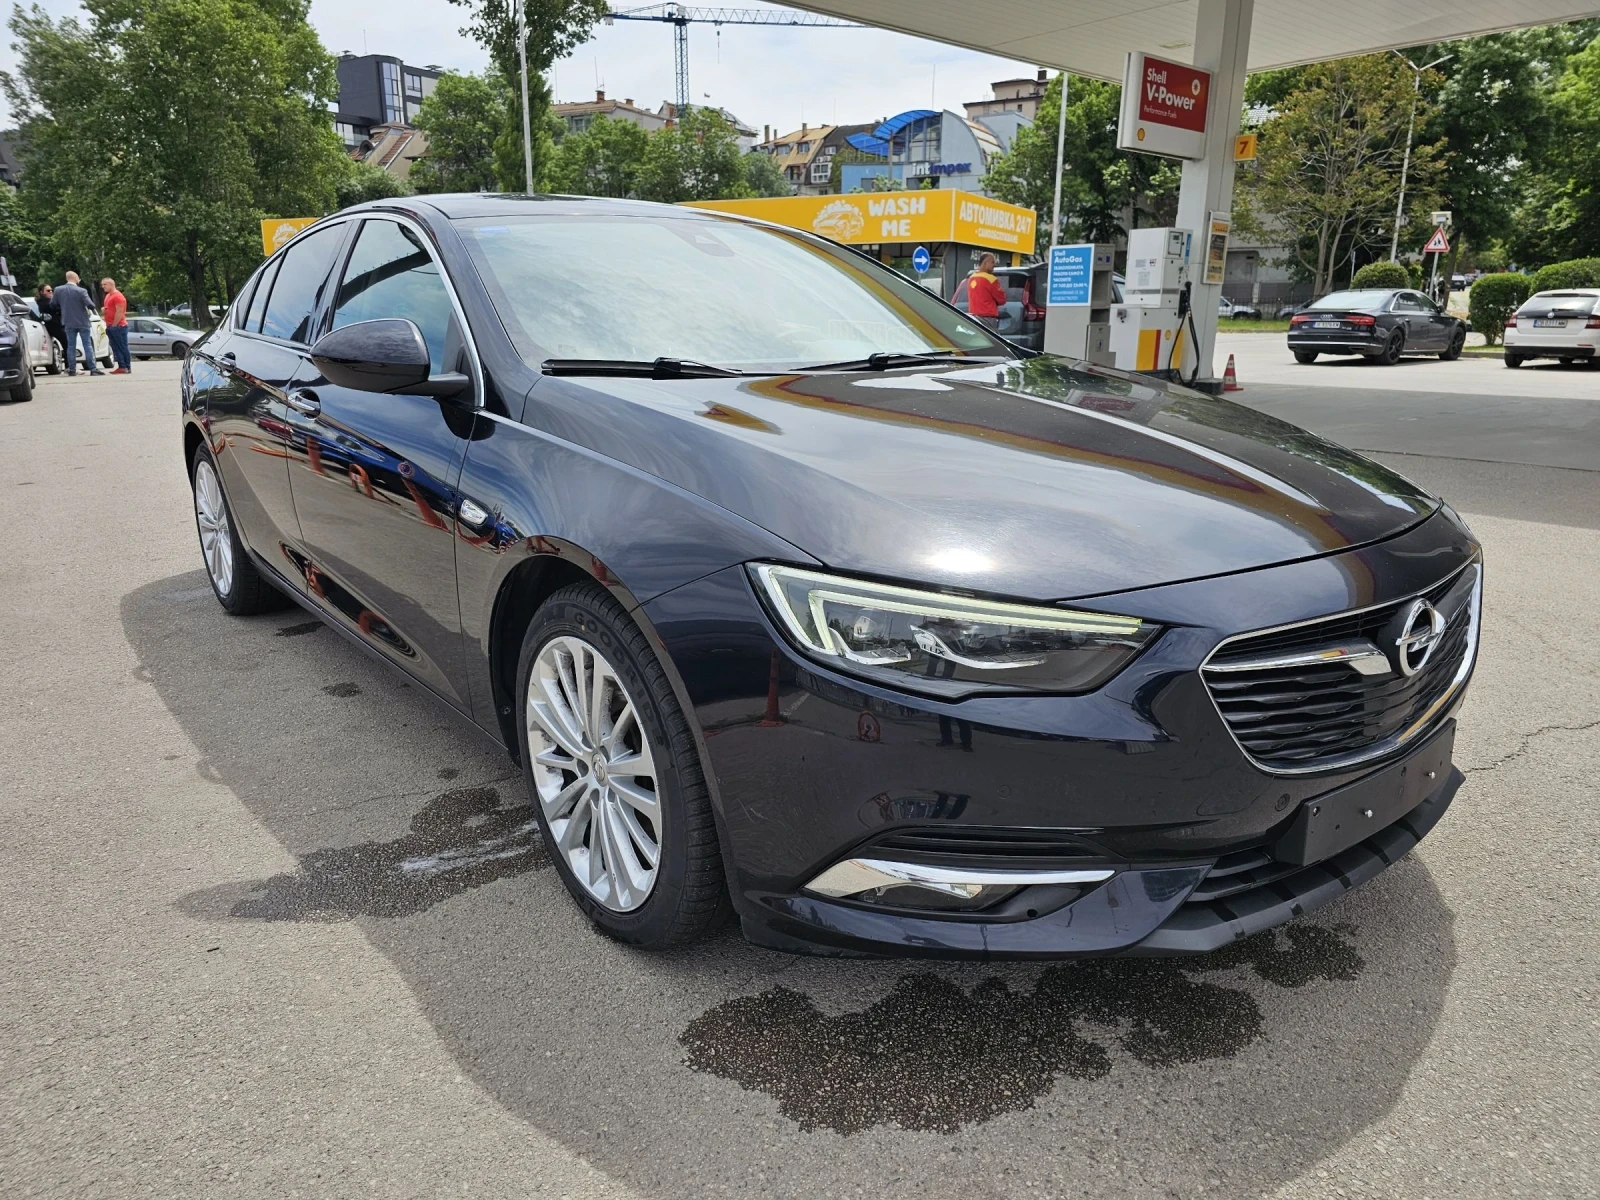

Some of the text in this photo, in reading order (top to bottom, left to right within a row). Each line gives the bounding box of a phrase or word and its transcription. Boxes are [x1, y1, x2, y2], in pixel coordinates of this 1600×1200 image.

[1147, 67, 1167, 84] Shell
[1146, 82, 1195, 111] V-Power
[1143, 104, 1167, 116] Performance
[1239, 140, 1249, 155] 7
[868, 196, 926, 217] WASH
[959, 200, 1033, 235] АВТОМИВКА 24/7
[881, 218, 912, 237] ME
[1054, 255, 1083, 264] AutoGas
